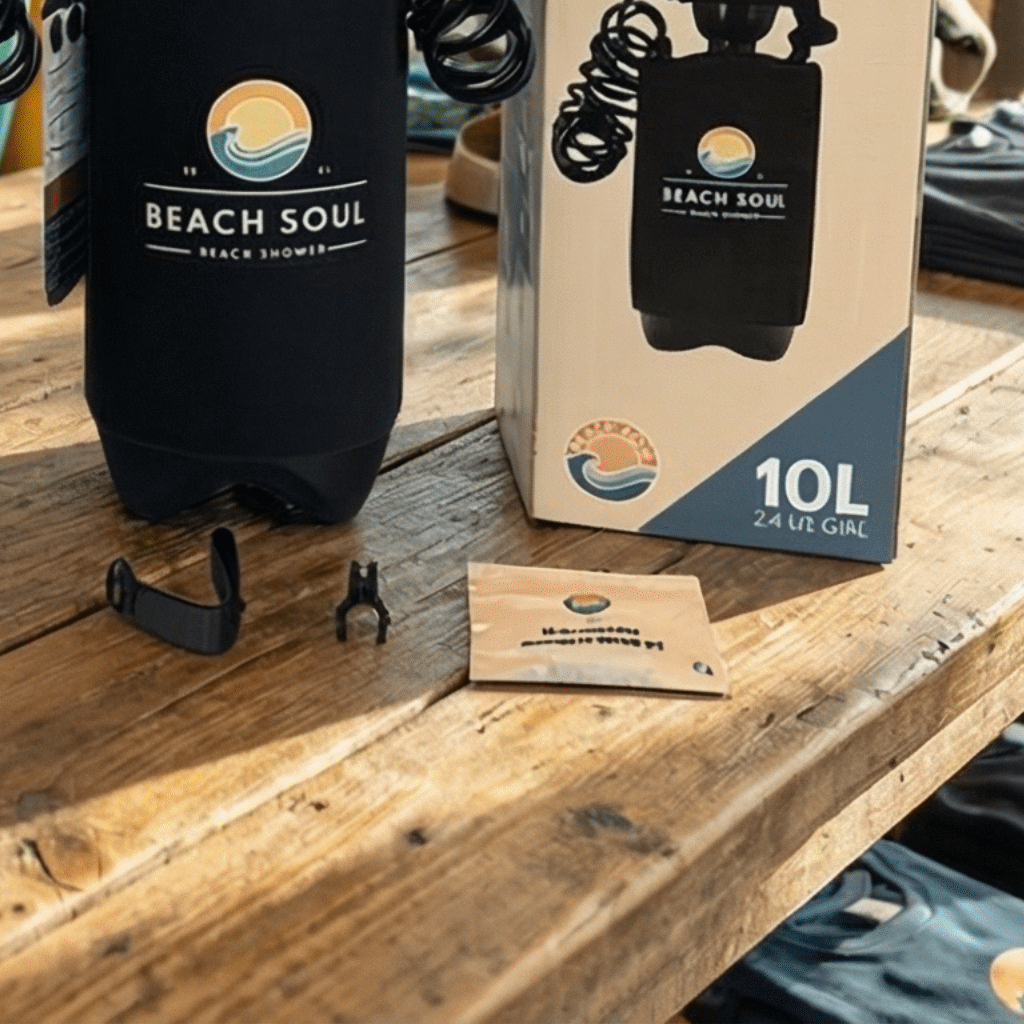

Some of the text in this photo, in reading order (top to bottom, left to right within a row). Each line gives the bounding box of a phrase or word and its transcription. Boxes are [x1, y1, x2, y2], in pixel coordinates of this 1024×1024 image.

[662, 186, 728, 206] BEACH
[145, 200, 365, 235] BEACH SOUL
[756, 456, 870, 517] 10L
